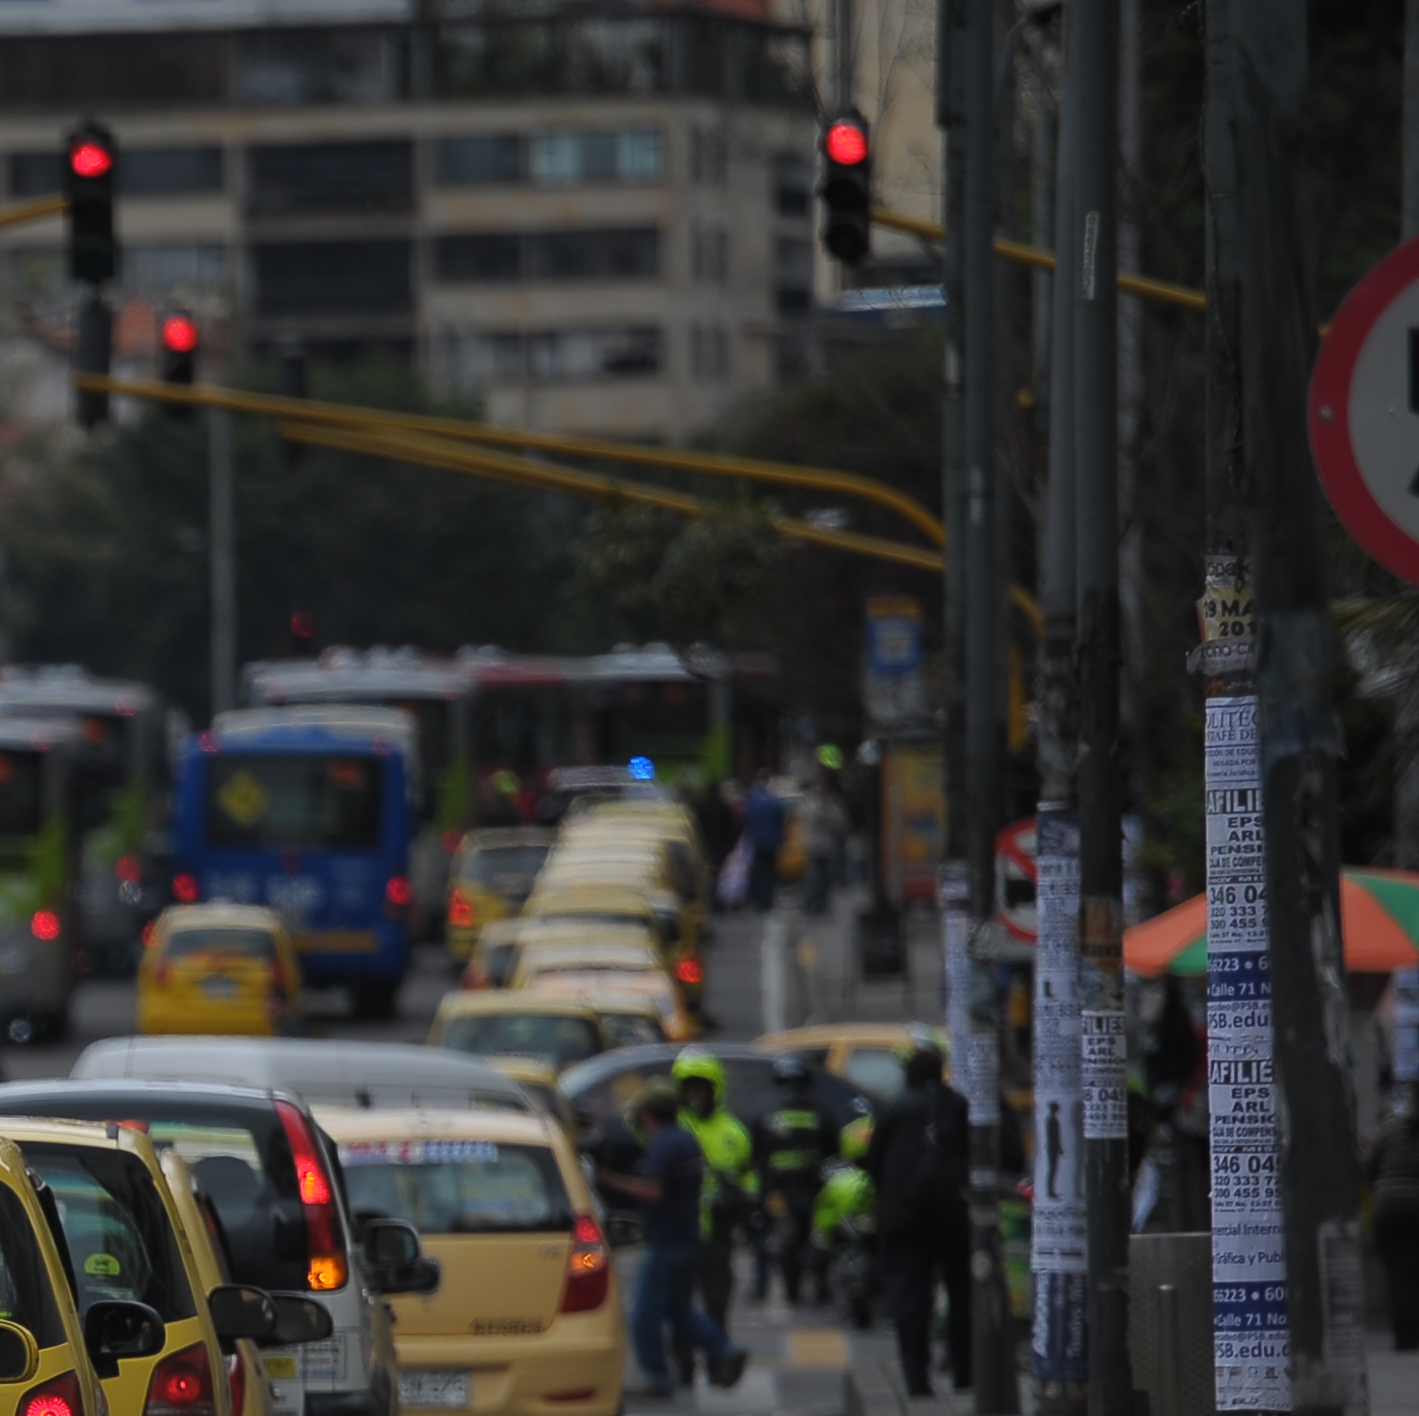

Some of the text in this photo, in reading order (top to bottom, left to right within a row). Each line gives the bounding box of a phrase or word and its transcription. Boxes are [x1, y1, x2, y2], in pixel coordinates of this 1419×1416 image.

[1229, 906, 1256, 917] 333
[1229, 918, 1257, 929] 455
[1238, 982, 1256, 996] 71
[1231, 1087, 1270, 1099] EPS
[1231, 1101, 1270, 1113] ARL
[1213, 1156, 1241, 1173] 346
[1233, 1176, 1260, 1186] 333
[1233, 1188, 1260, 1198] 455
[1245, 1313, 1262, 1326] 71
